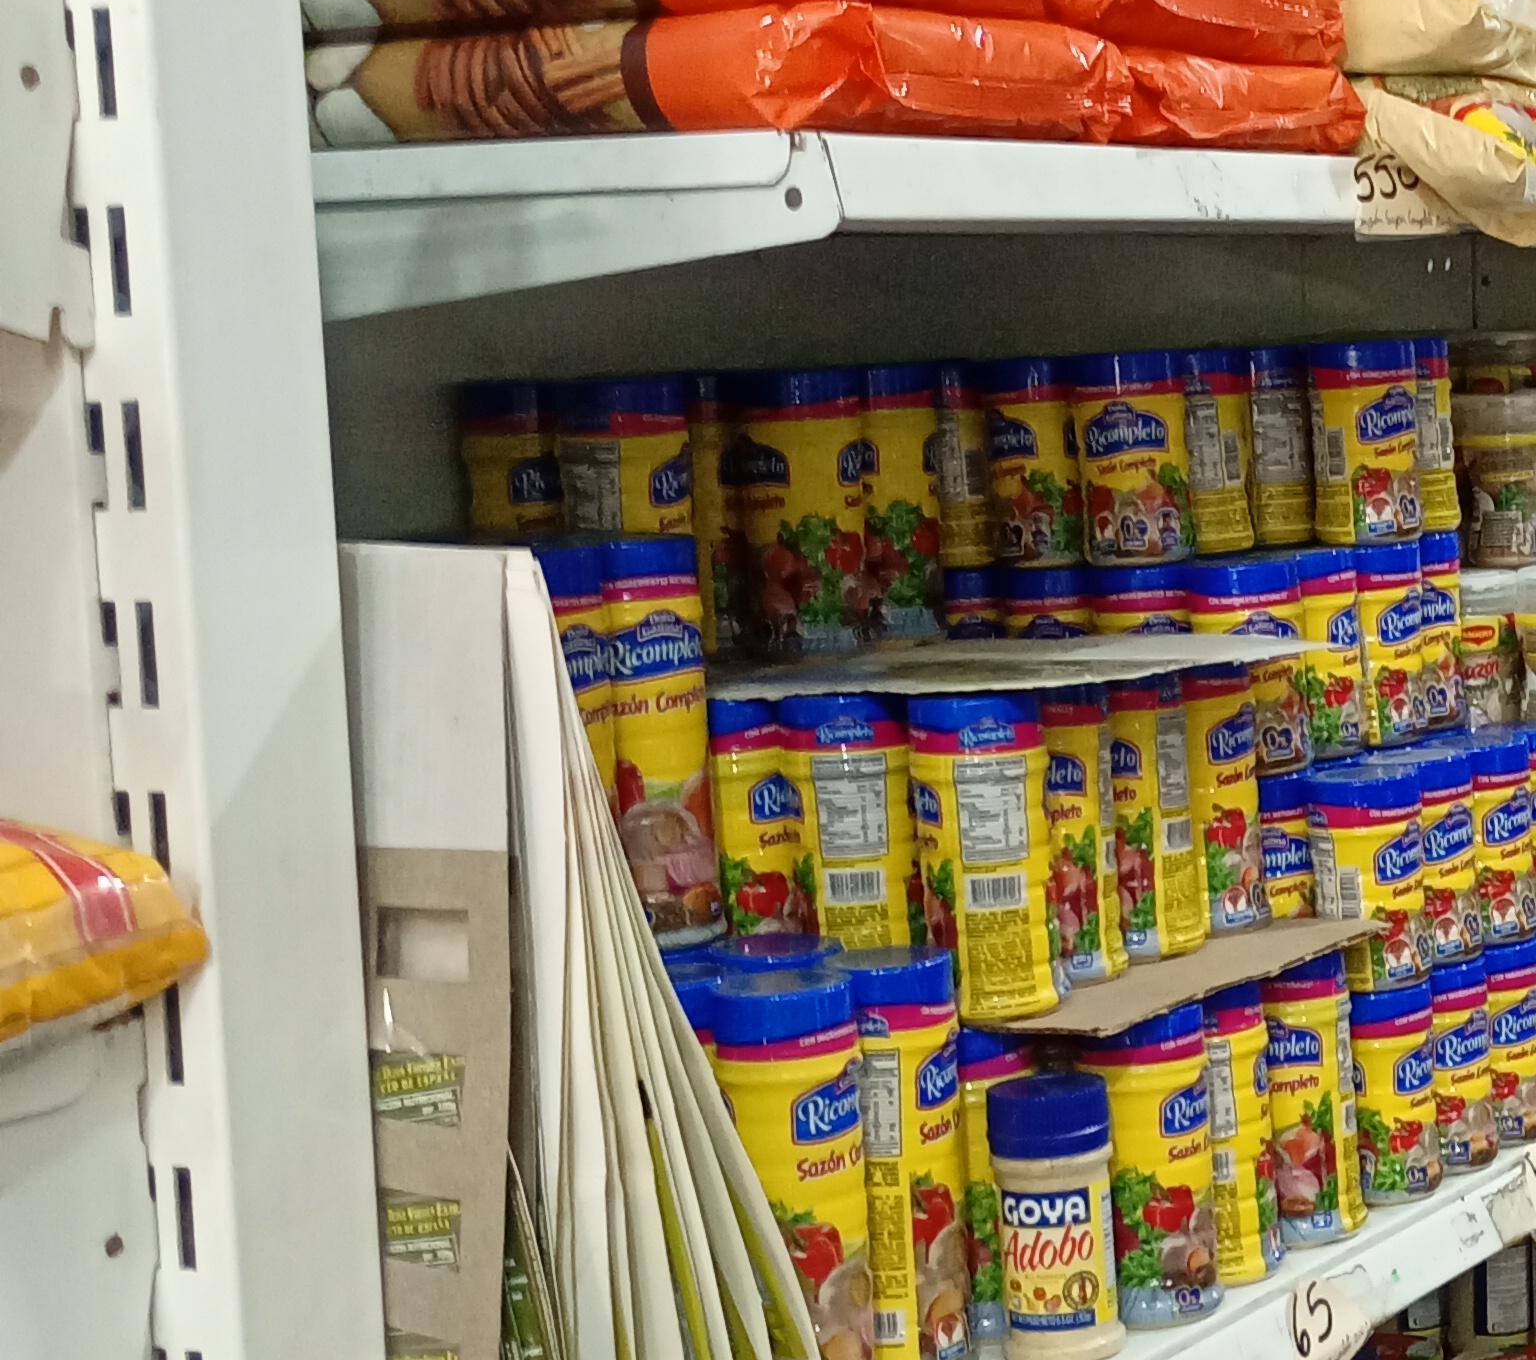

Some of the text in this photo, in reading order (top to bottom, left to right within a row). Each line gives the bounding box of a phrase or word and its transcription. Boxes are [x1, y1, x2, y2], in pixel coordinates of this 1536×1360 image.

[1086, 419, 1165, 454] Ricompleto
[919, 1117, 951, 1145] Sazón
[796, 1155, 846, 1182] Sazón
[1003, 1195, 1087, 1225] GOYA
[1003, 1229, 1094, 1274] Adobo
[1291, 1279, 1333, 1359] 65
